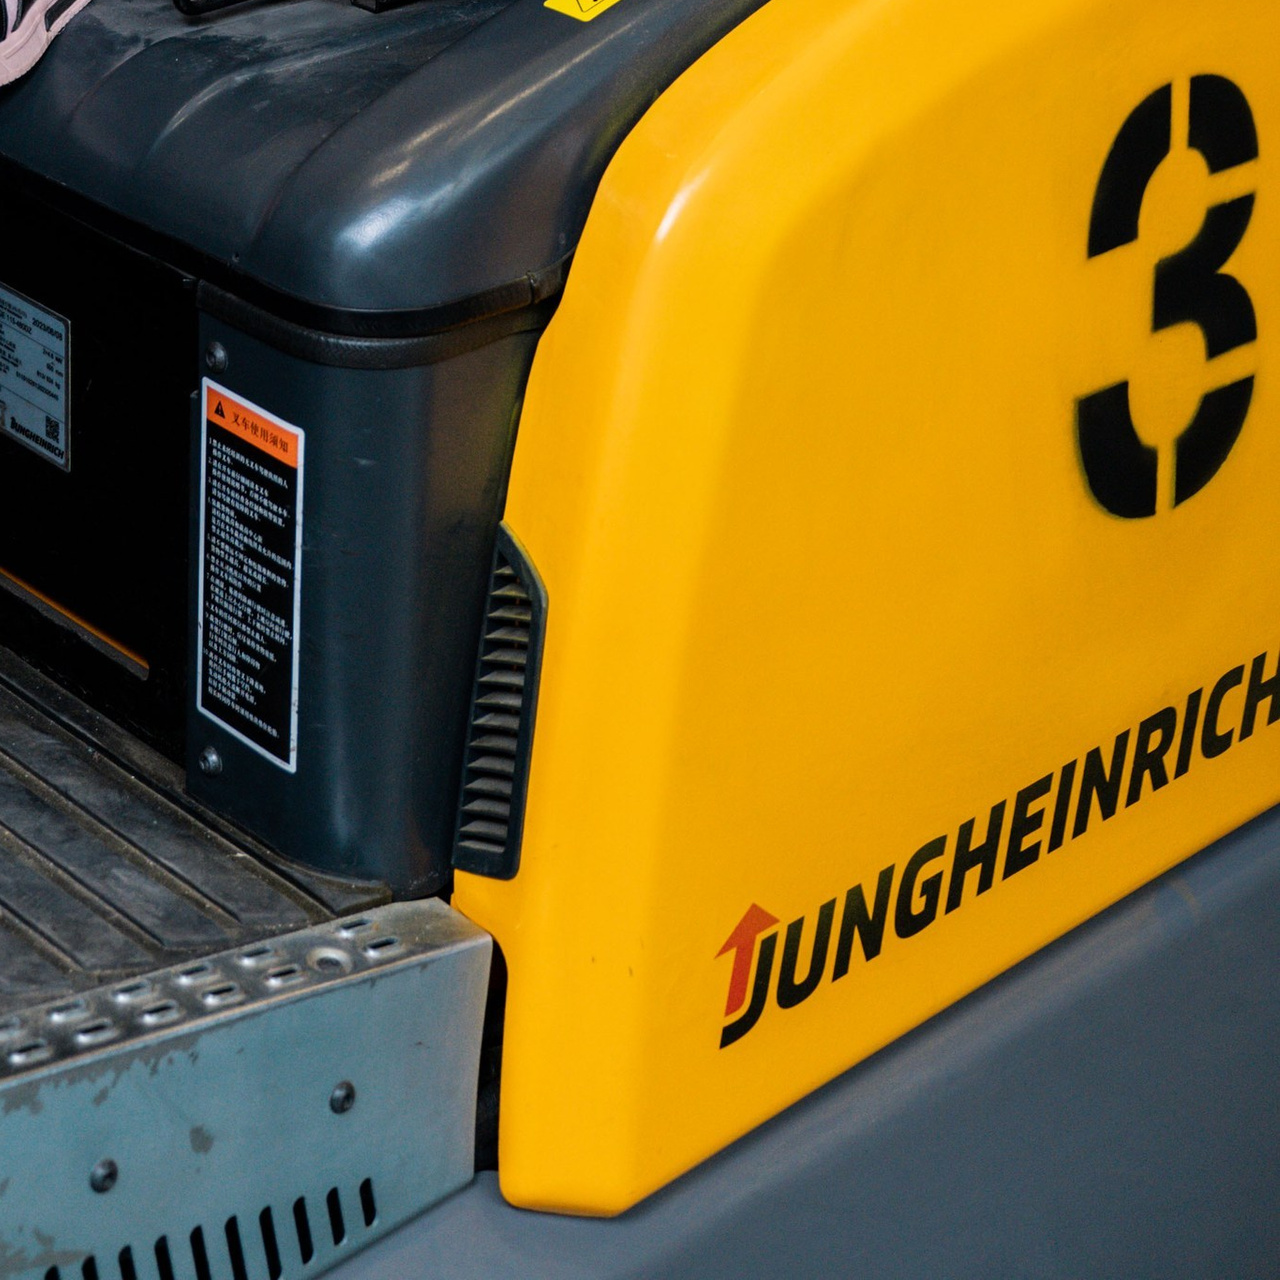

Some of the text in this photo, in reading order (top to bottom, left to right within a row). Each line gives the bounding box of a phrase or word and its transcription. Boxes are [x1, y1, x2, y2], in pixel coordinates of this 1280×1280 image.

[1075, 74, 1258, 519] 3
[10, 417, 65, 460] JUNGHEINRICH
[232, 412, 289, 453] 叉车使用须知
[717, 650, 1280, 1048] JUNGHEINRICH
